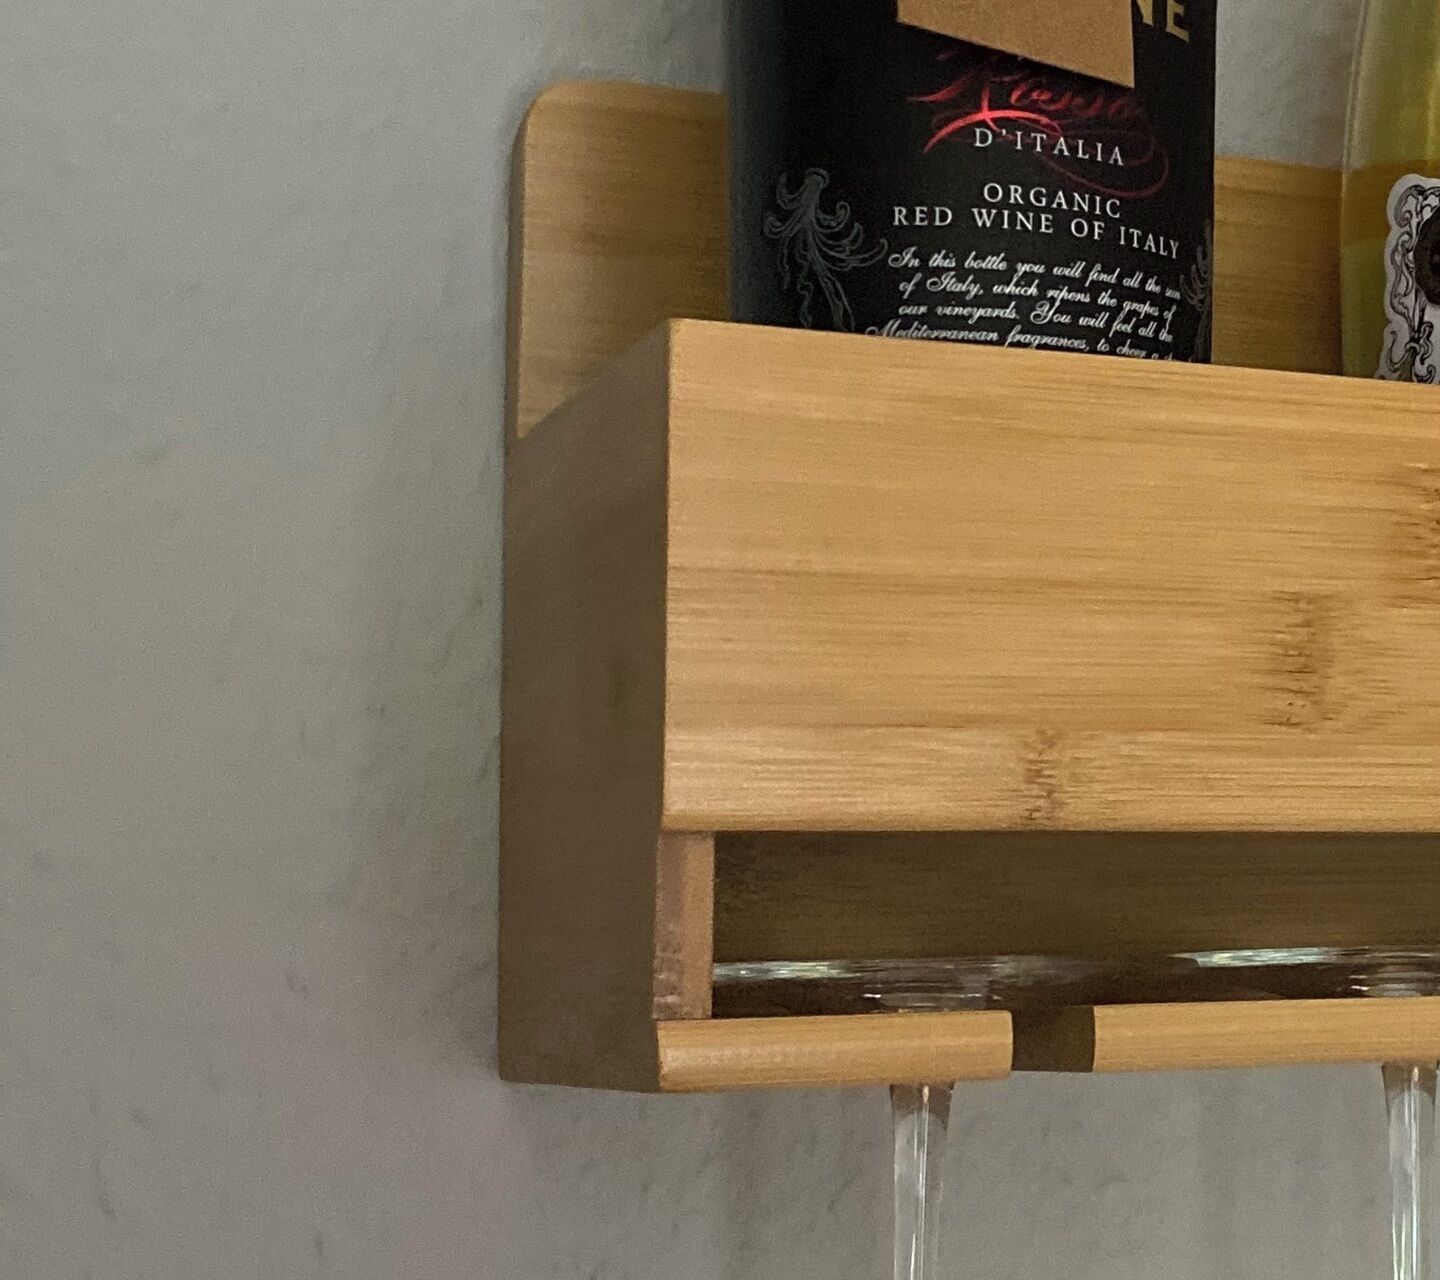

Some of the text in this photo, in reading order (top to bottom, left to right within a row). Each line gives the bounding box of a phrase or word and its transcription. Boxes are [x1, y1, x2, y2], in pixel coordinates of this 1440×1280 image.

[974, 127, 1125, 166] D'ITALIA
[982, 182, 1122, 219] ORGANIC
[892, 206, 1180, 259] RED WINE OF ITALY
[887, 246, 921, 268] In
[928, 249, 957, 268] this
[964, 250, 1008, 271] bottle
[1015, 261, 1046, 278] you
[1052, 261, 1087, 279] will
[1084, 263, 1121, 288] find
[1122, 271, 1144, 289] all
[1145, 275, 1162, 295] the
[898, 270, 1178, 330] of Italy, which ripens the grapes of
[898, 300, 1174, 344] our vineyards. You will feel all the
[864, 317, 999, 342] Mediterranean
[1004, 323, 1090, 352] fragrances,
[1096, 337, 1111, 353] to
